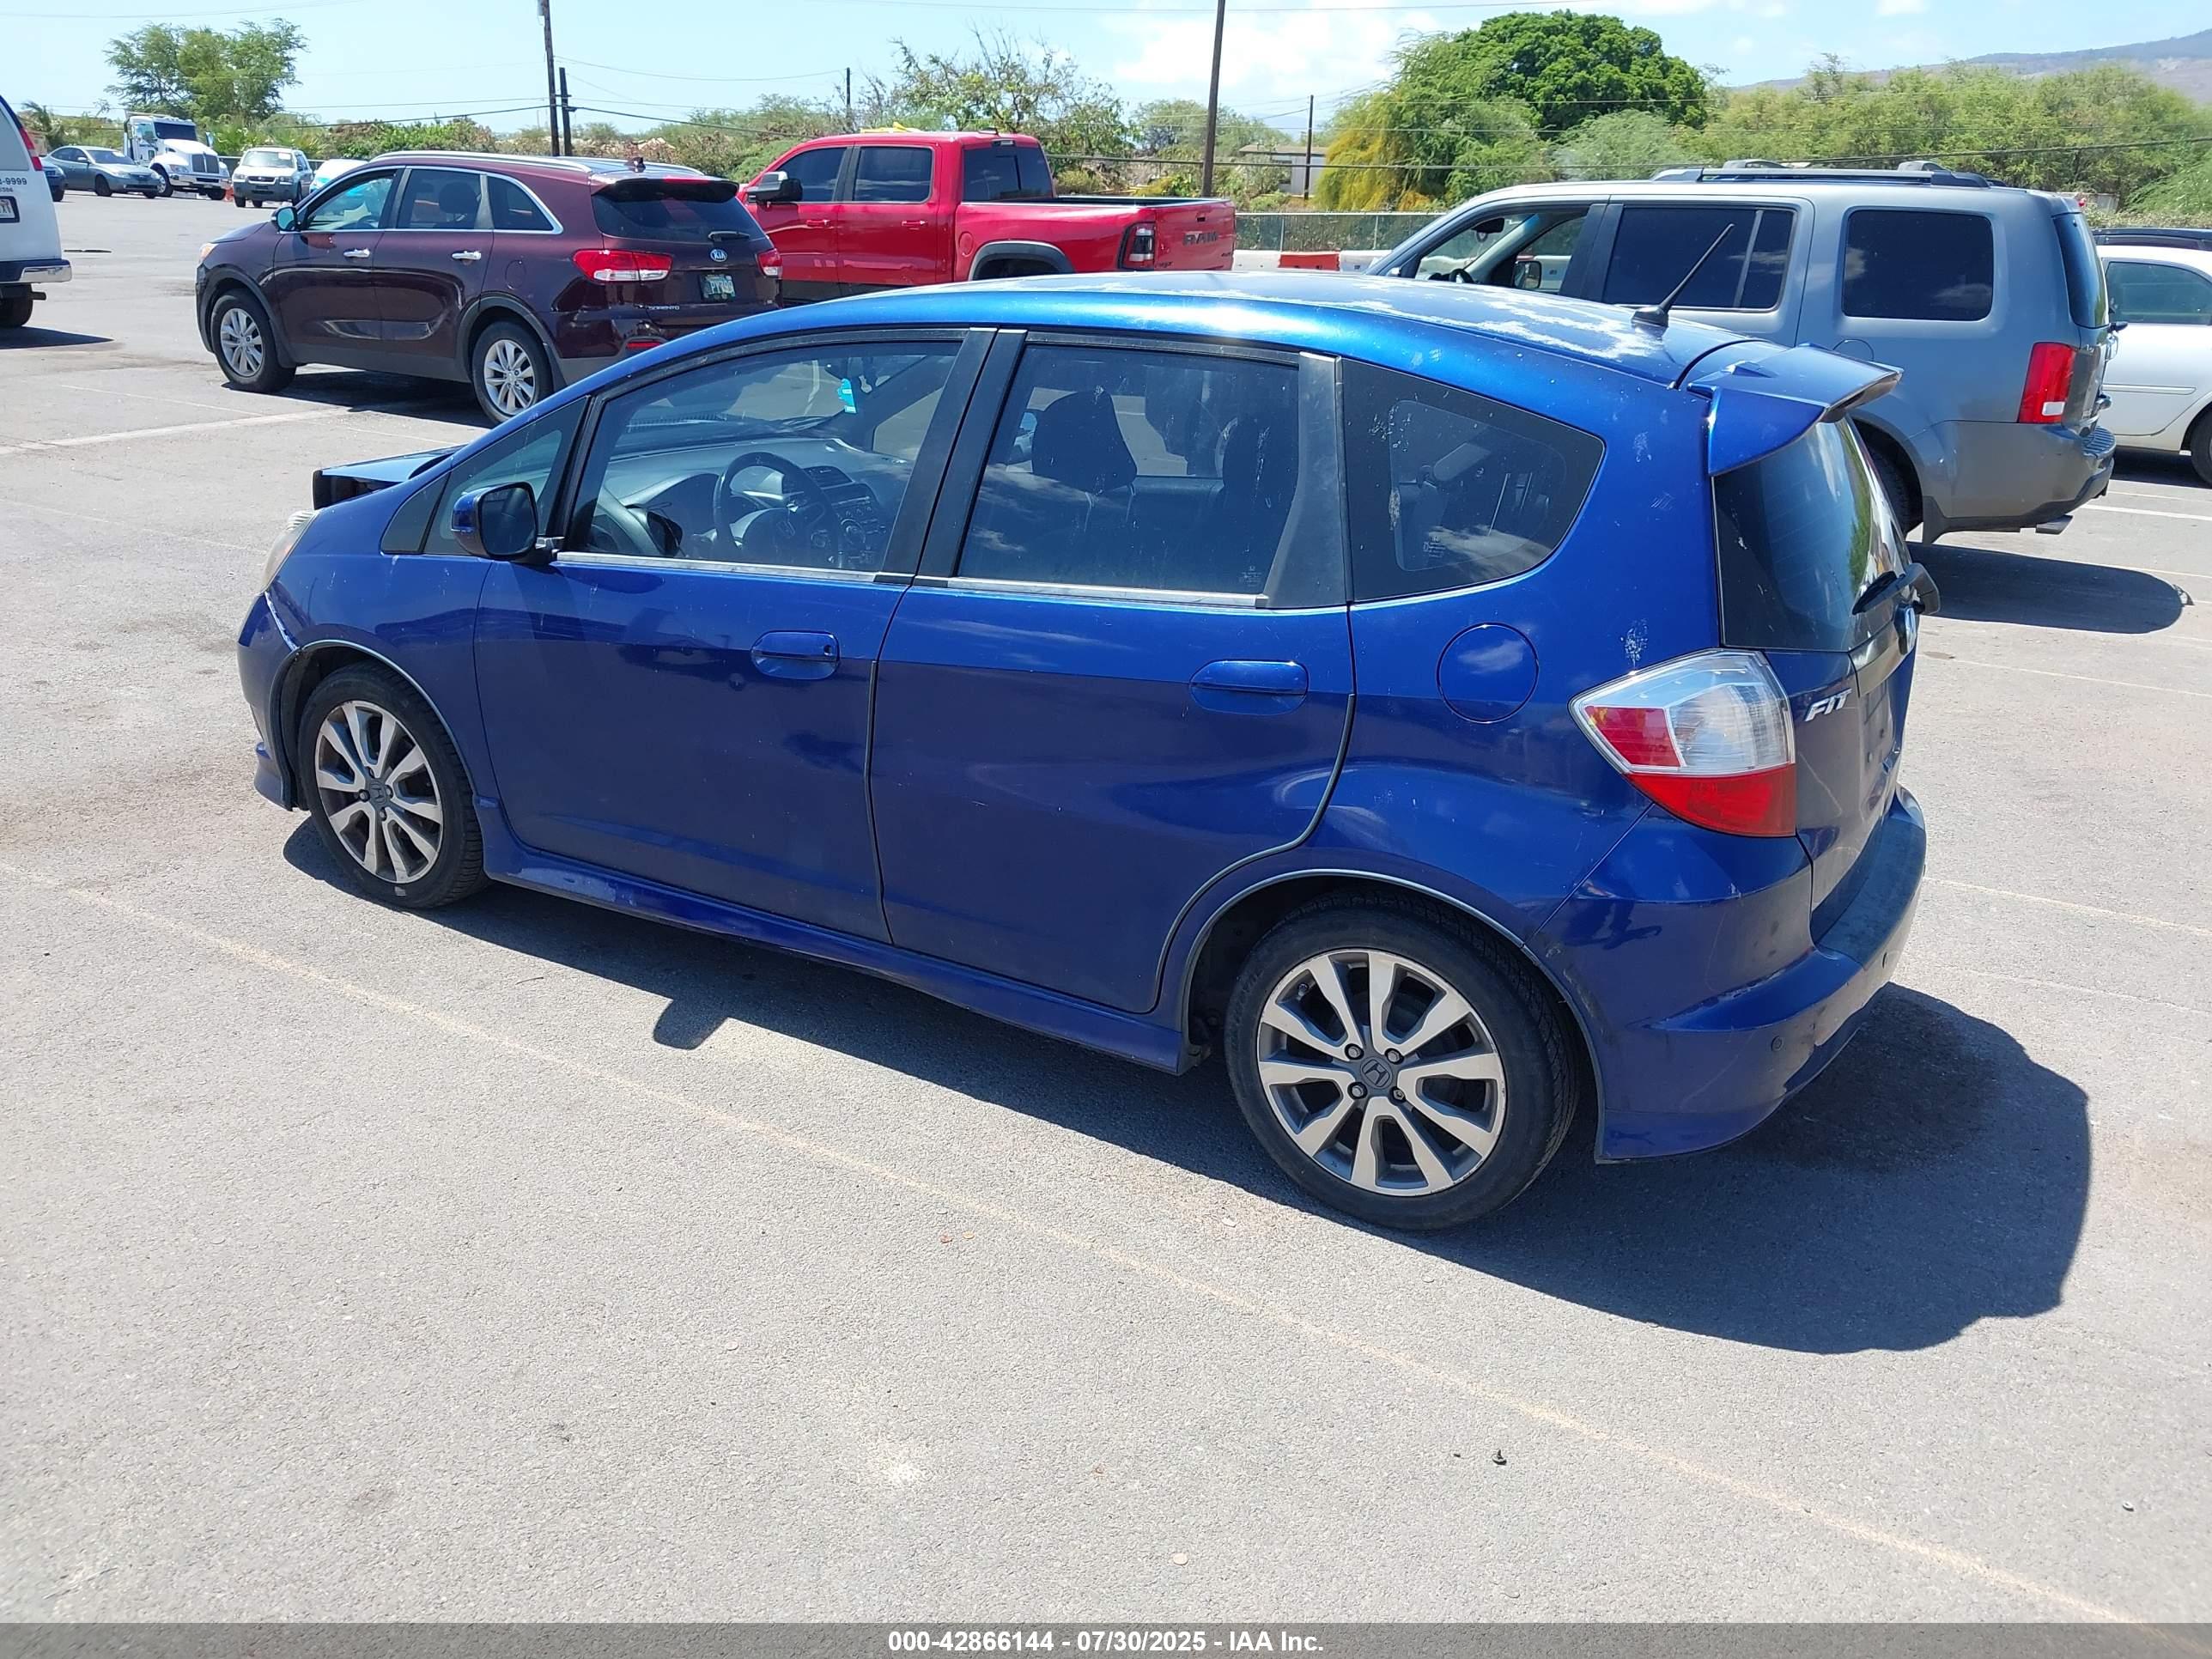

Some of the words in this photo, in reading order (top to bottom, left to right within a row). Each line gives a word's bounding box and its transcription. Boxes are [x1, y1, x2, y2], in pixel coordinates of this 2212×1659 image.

[1182, 231, 1218, 246] RAM
[714, 250, 726, 260] KIA
[1804, 688, 1852, 722] FIT
